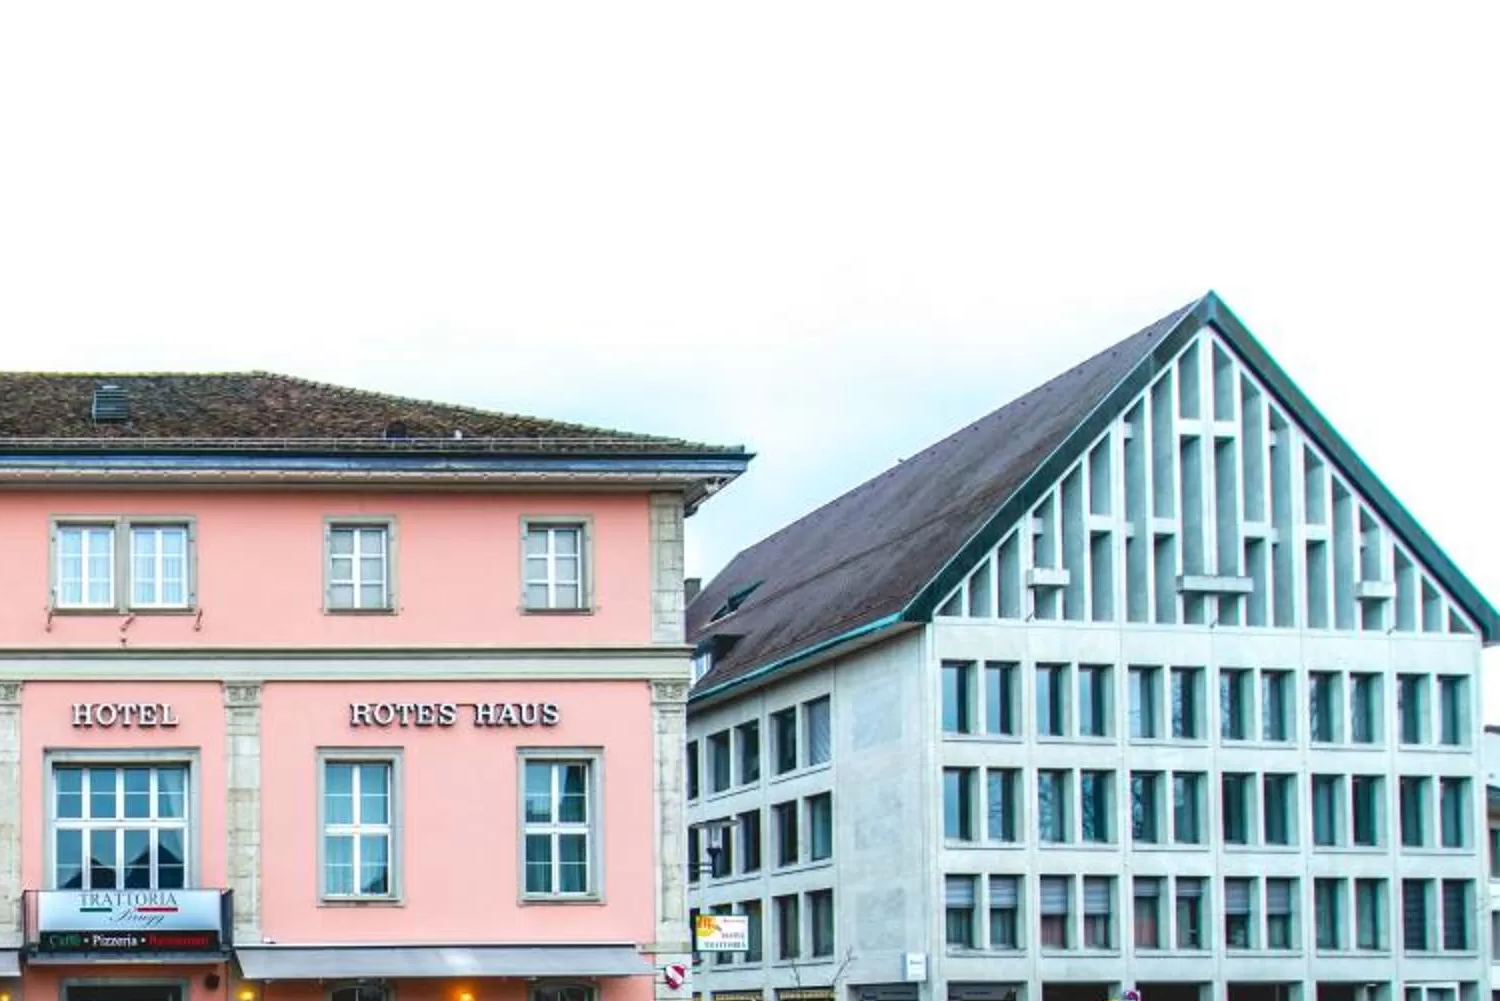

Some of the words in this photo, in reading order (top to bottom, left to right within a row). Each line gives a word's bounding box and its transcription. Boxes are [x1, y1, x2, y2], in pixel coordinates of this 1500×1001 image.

[71, 703, 180, 728] HOTEL
[351, 703, 457, 728] ROTES
[474, 703, 560, 728] HAUS
[79, 892, 178, 907] TRATTORIA
[92, 935, 138, 948] Pizzeria
